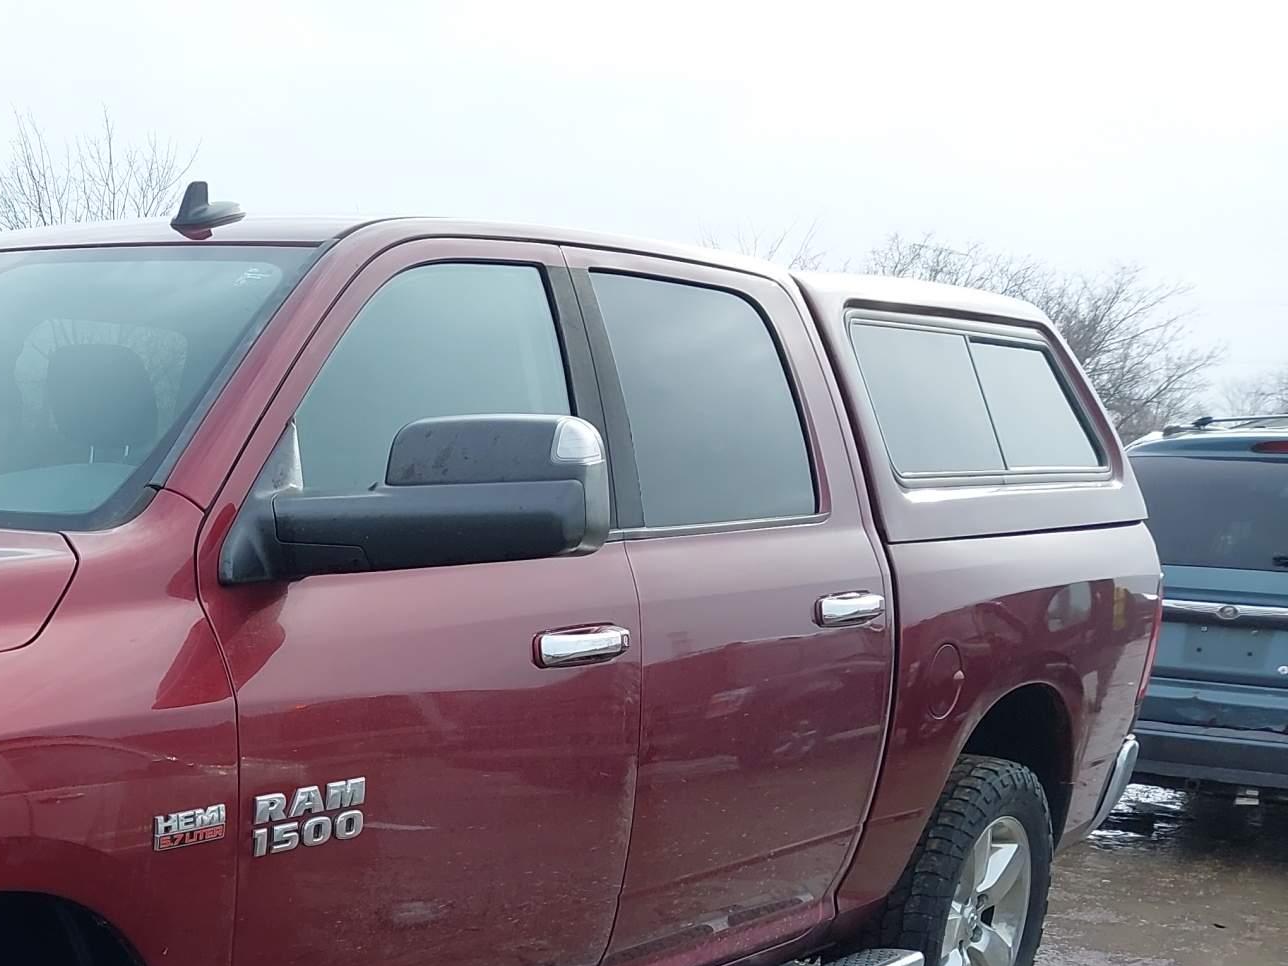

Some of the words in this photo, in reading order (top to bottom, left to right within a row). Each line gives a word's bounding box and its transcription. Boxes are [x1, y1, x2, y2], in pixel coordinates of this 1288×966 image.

[154, 804, 225, 836] HEMI
[255, 777, 366, 824] RAM
[159, 833, 184, 849] 5.7
[185, 825, 224, 844] LITER
[253, 809, 364, 857] 1500
